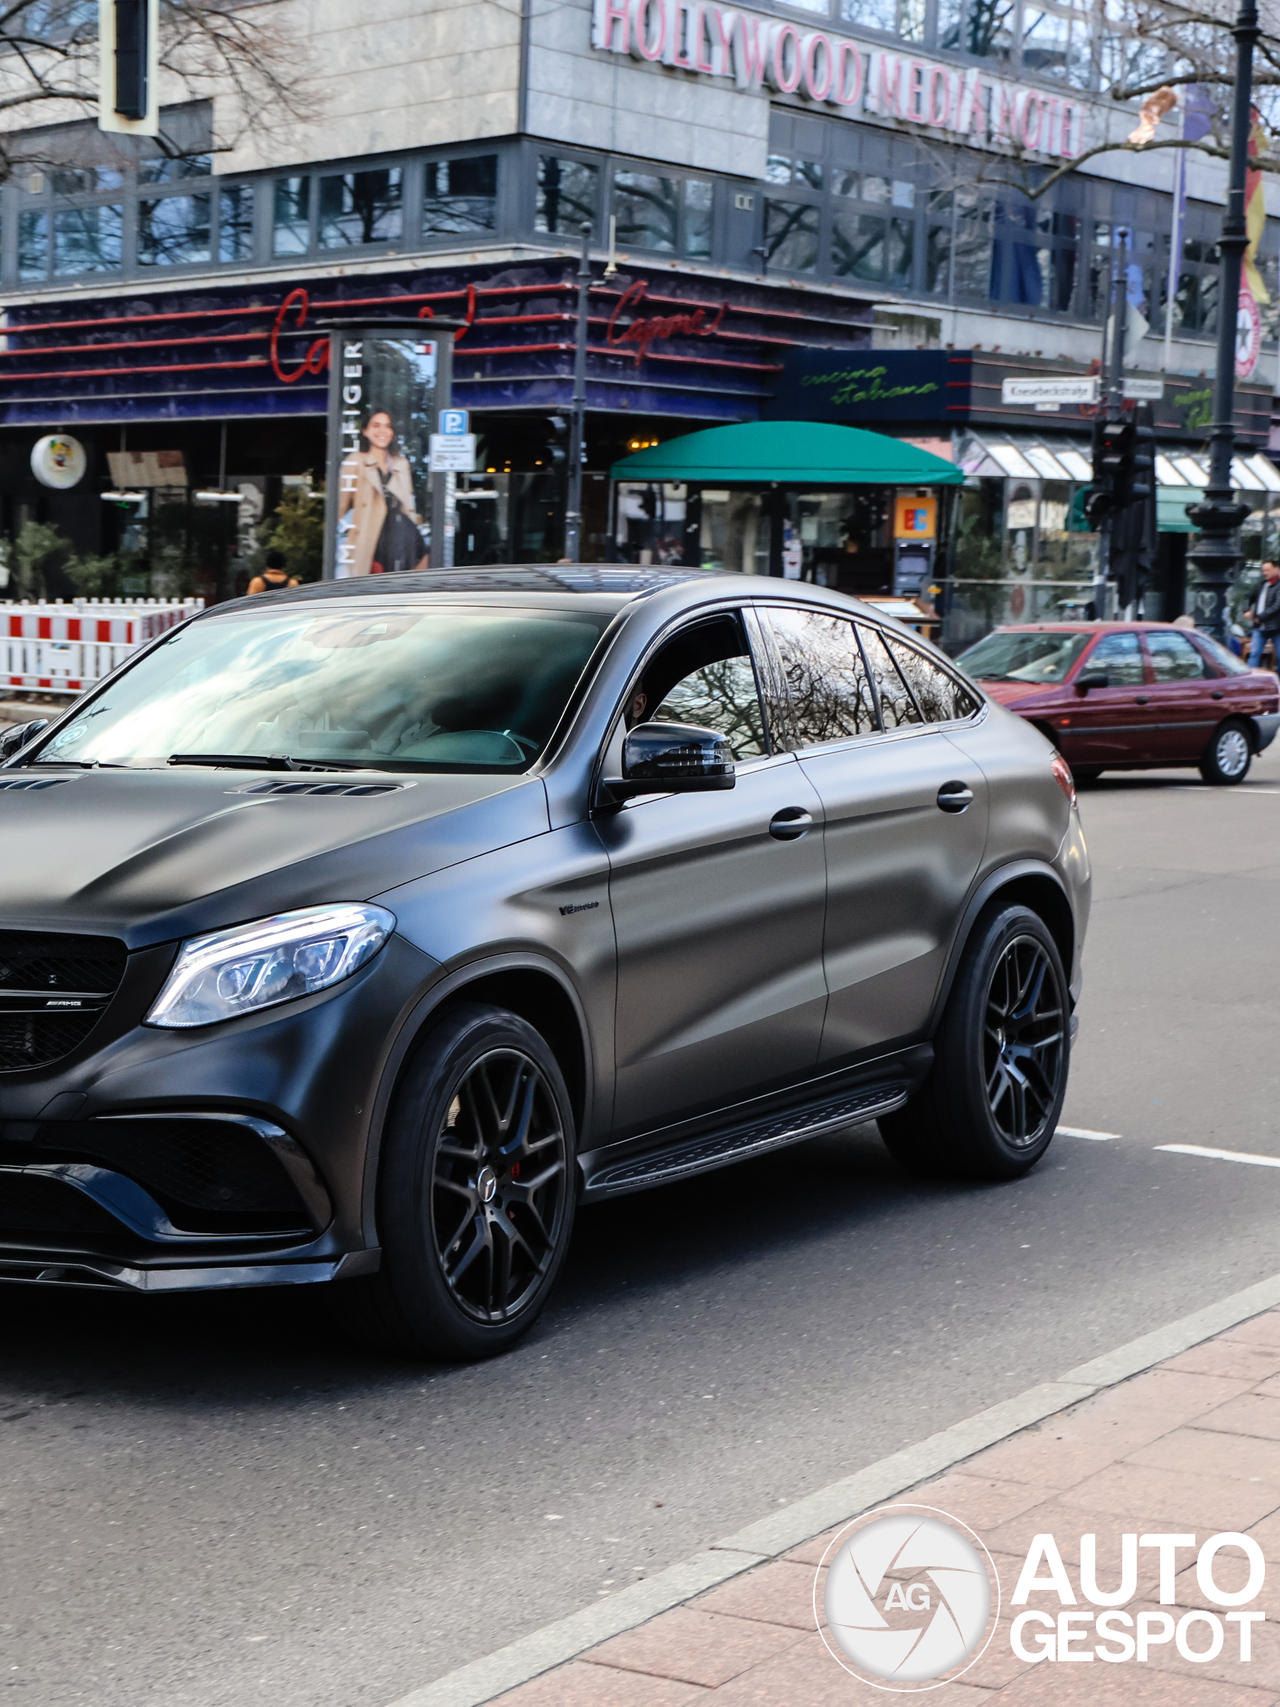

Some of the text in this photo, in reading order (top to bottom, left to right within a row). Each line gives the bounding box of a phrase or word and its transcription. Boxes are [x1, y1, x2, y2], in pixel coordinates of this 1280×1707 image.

[600, 0, 862, 105] HOLLYWOOD
[876, 53, 987, 136] MEDIA
[341, 340, 363, 493] HILFIGER
